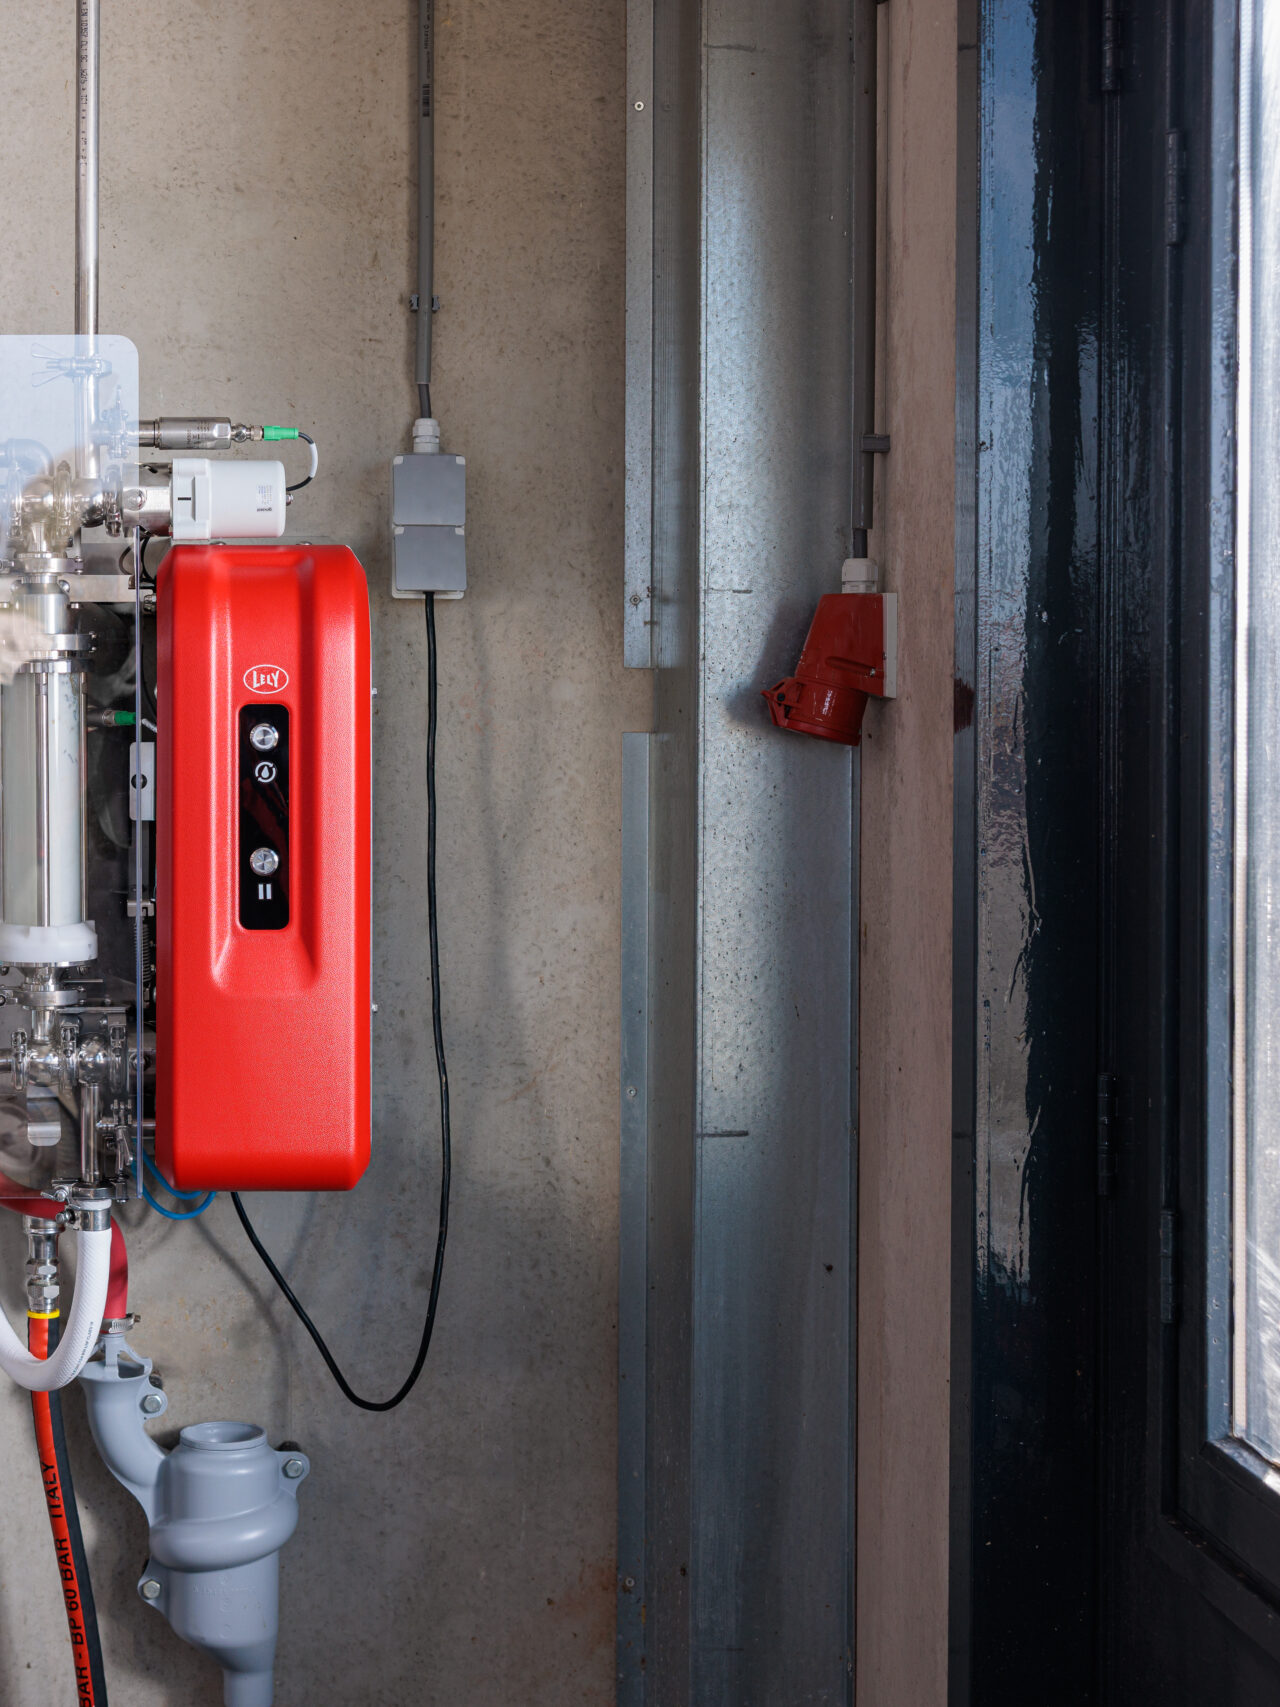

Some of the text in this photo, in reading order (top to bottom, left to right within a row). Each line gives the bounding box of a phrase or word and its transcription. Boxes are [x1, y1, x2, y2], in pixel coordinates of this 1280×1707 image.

[252, 670, 280, 689] LELY
[42, 1461, 63, 1518] ITALY
[55, 1538, 74, 1581] BAR
[65, 1589, 79, 1611] 60
[69, 1617, 84, 1646] BP
[75, 1667, 92, 1707] BAR
